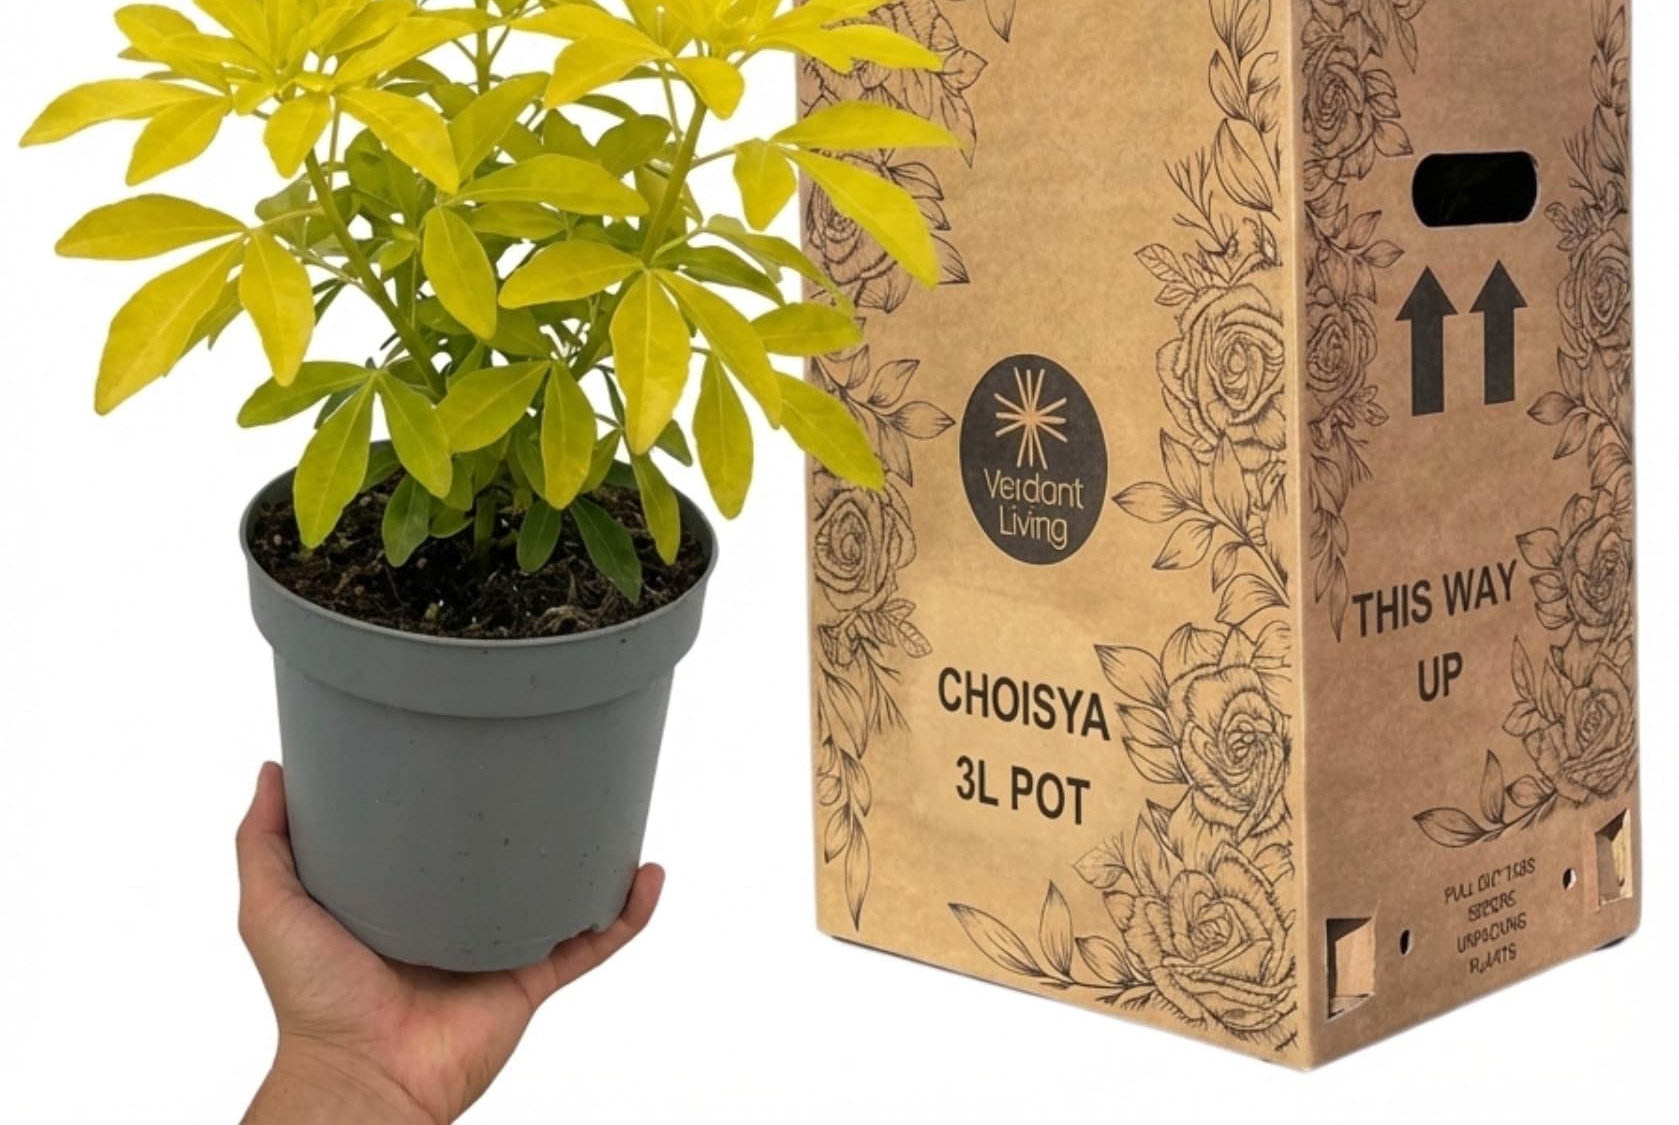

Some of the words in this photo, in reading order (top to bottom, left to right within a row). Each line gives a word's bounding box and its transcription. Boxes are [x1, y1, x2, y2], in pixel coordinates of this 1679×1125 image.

[983, 467, 1084, 510] Verdant
[999, 504, 1068, 550] Living
[1352, 579, 1432, 637] THIS
[1442, 559, 1517, 617] WAY
[938, 666, 1111, 742] CHOISYA
[1418, 651, 1463, 702] UP
[956, 755, 999, 807] 3L
[1011, 765, 1091, 826] POT
